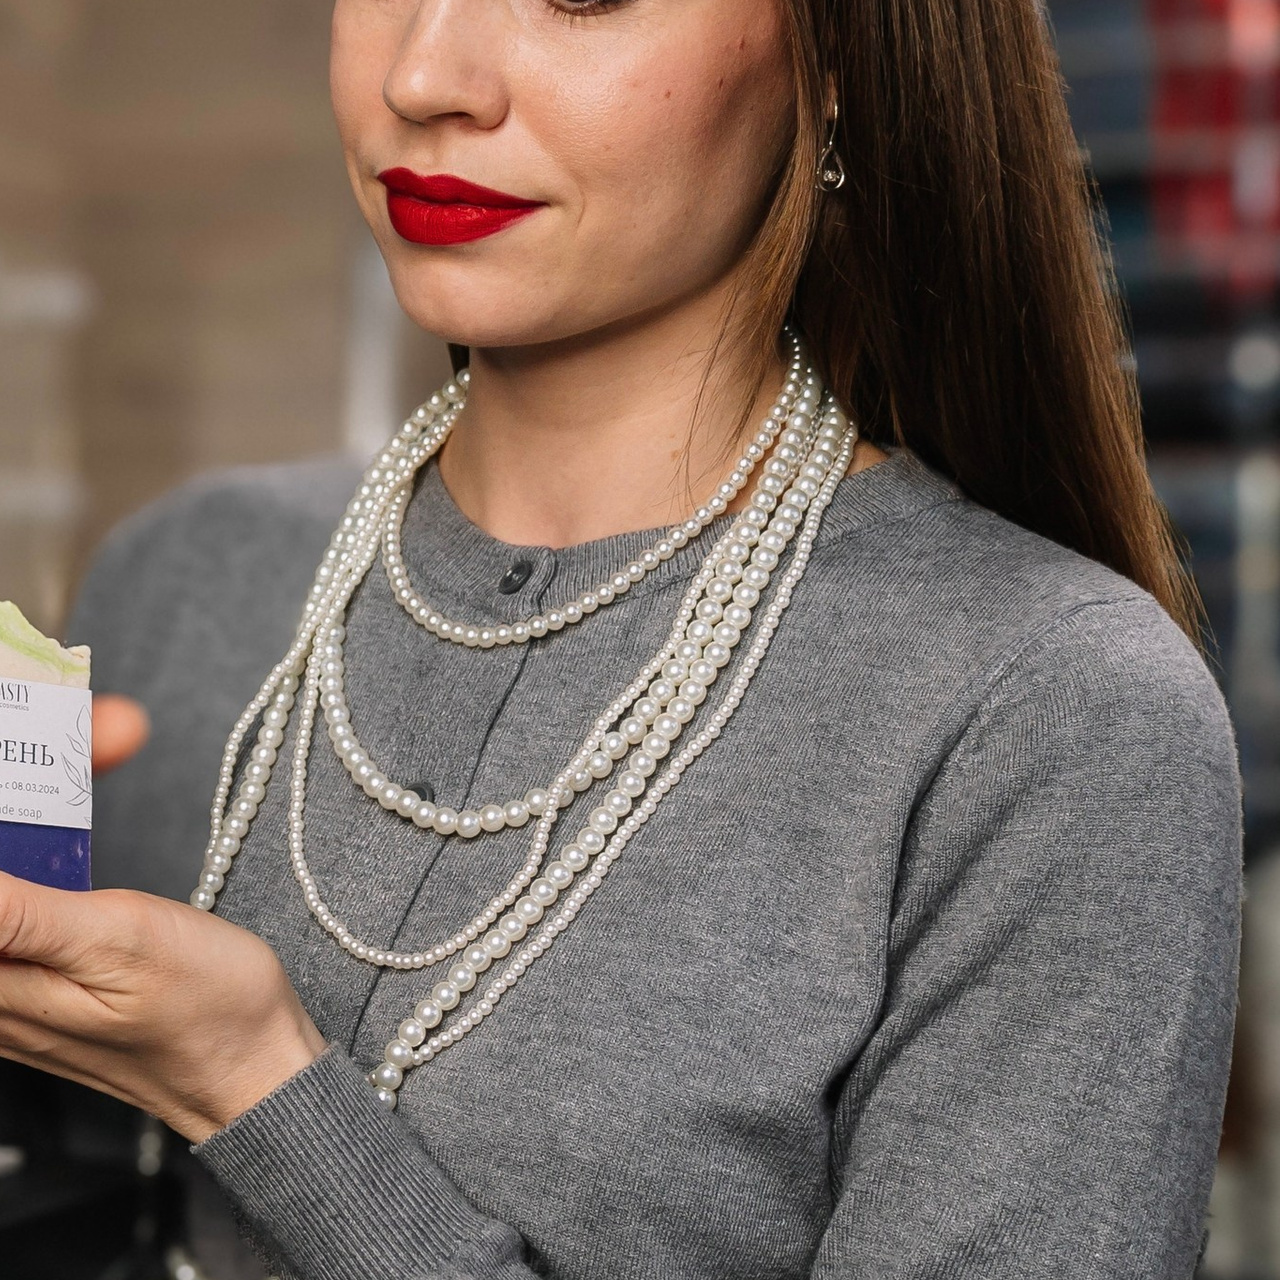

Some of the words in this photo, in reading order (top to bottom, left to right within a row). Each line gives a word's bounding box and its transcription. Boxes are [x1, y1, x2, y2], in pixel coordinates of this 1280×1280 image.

[0, 701, 30, 711] cosmetics
[11, 780, 60, 795] 08.03.2024
[18, 807, 43, 820] soap
